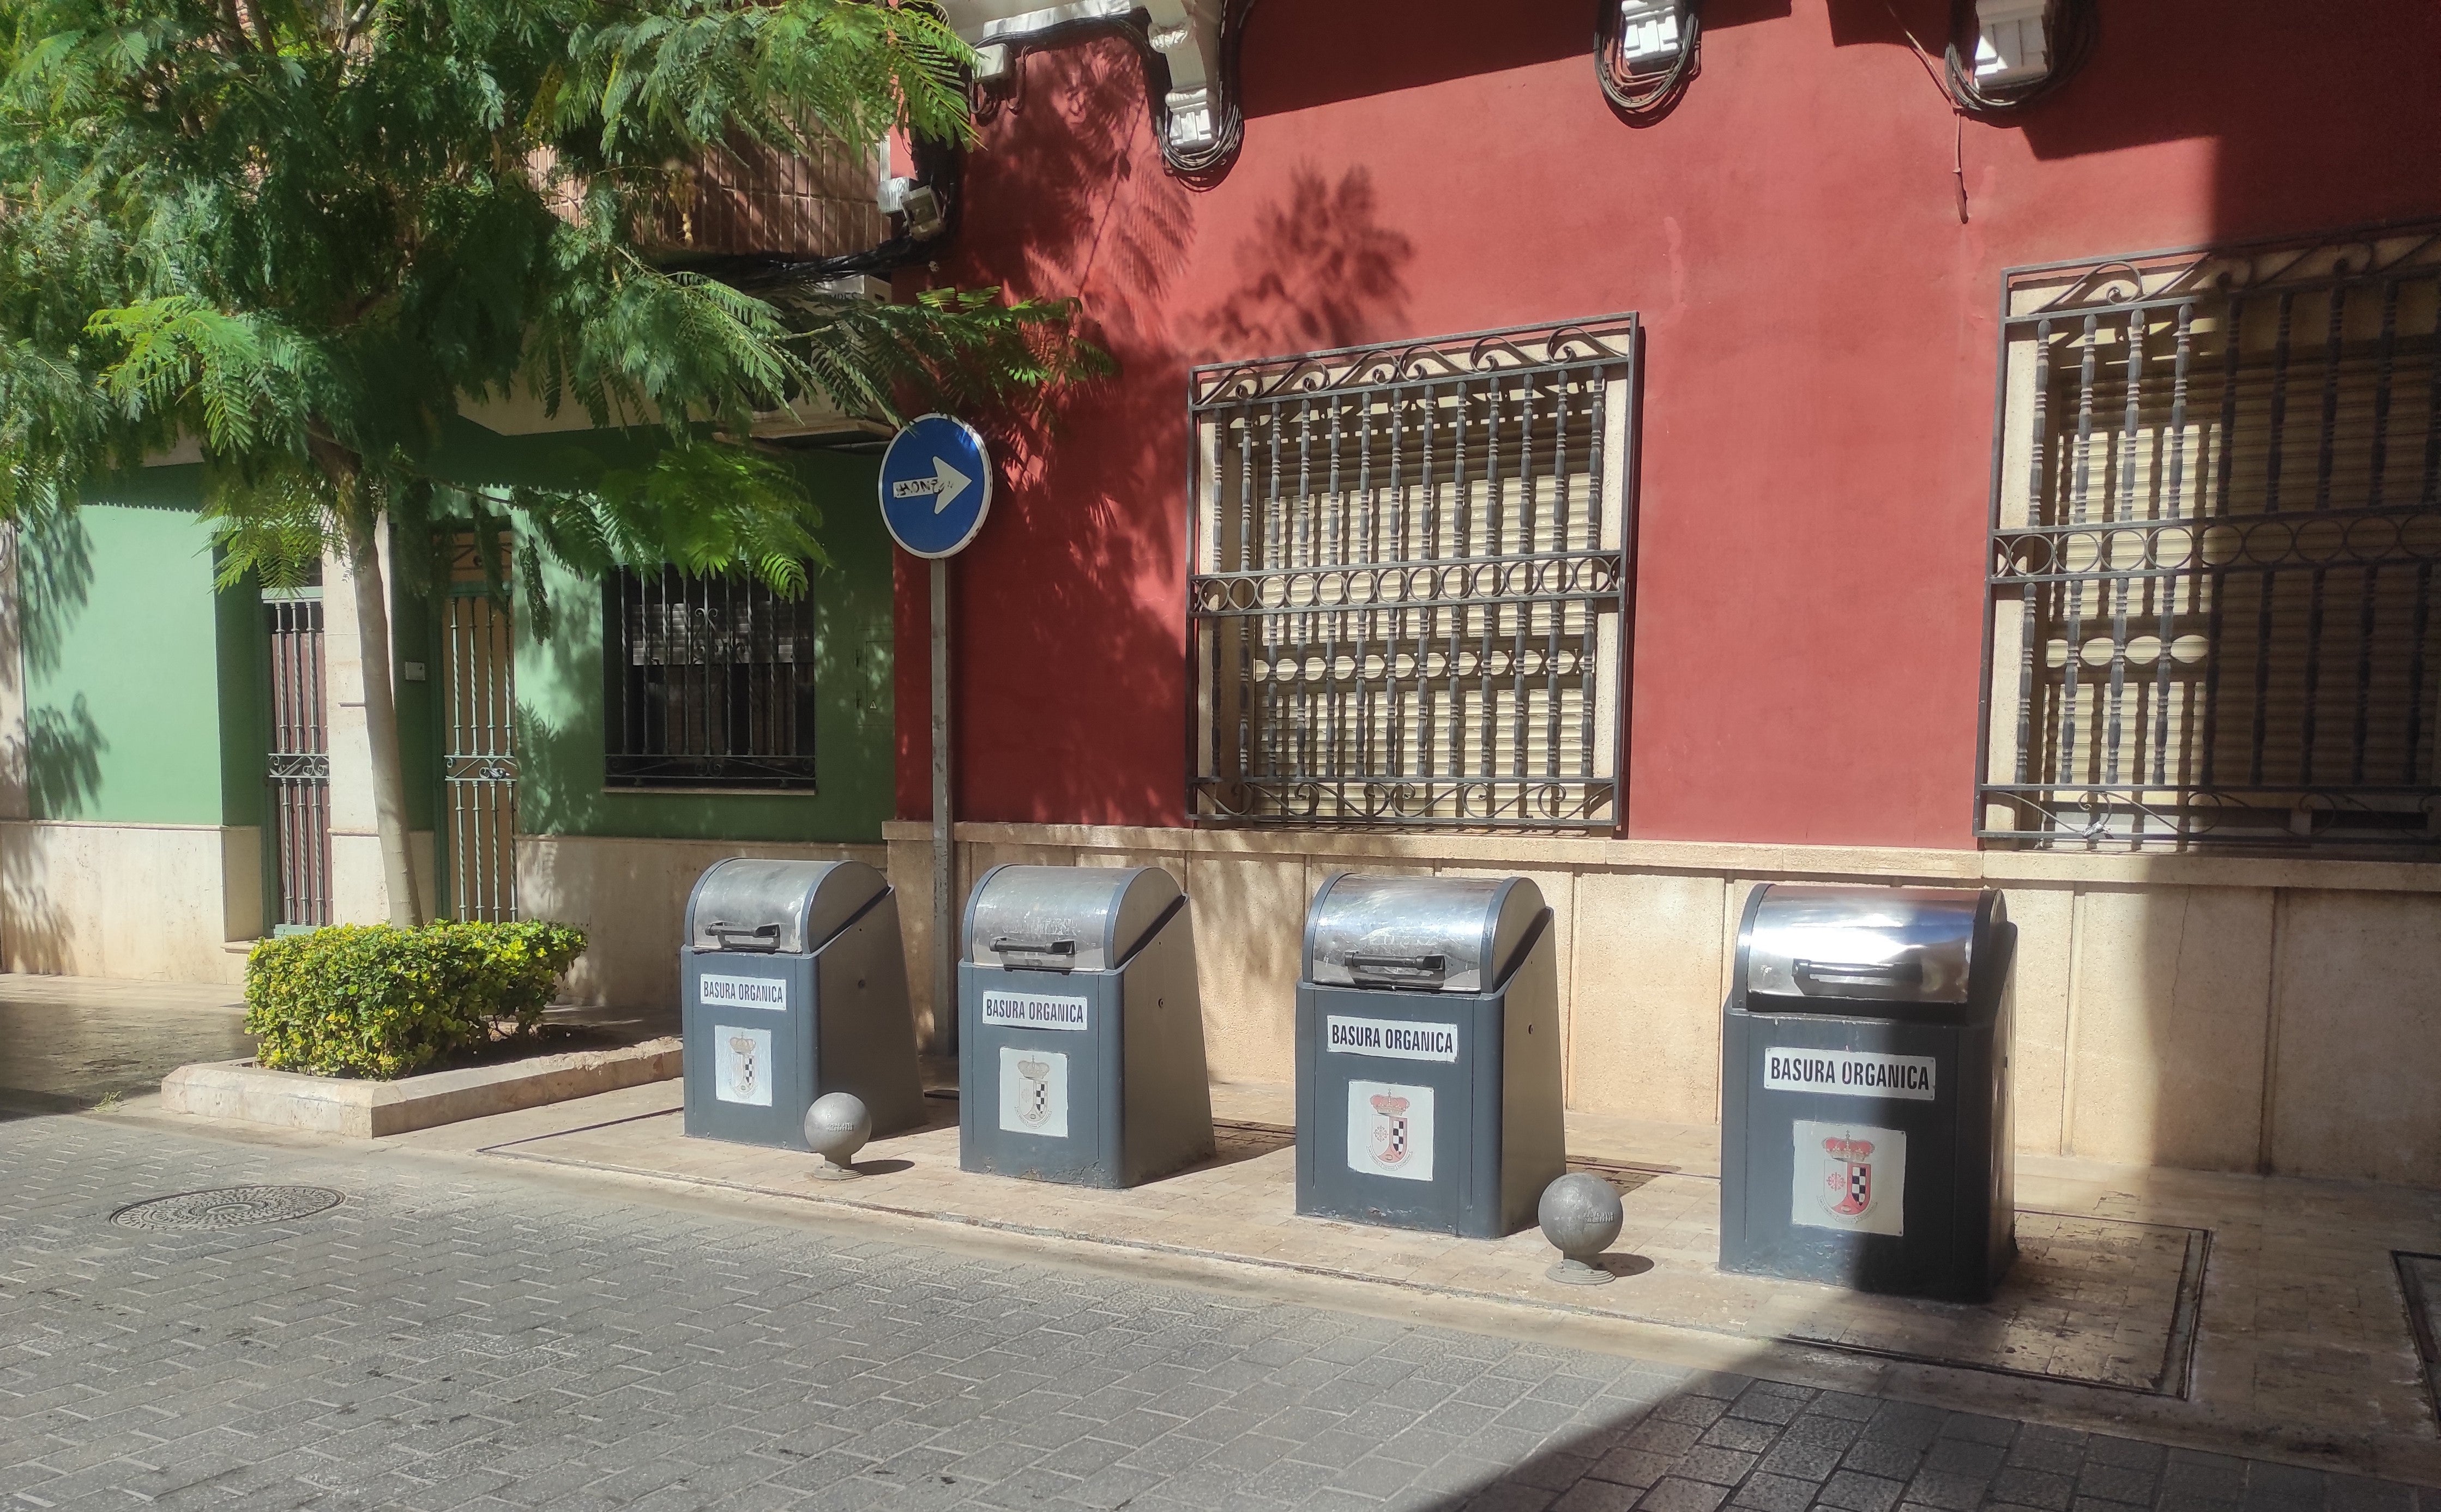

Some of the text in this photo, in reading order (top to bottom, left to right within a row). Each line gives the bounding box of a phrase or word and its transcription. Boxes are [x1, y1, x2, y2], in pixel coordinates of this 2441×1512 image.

[704, 981, 783, 1003] BASURA ORGANICA
[986, 999, 1083, 1023] BASURA ORGANICA
[1332, 1024, 1453, 1053] BASURA ORGANICA
[1771, 1057, 1929, 1090] BASURA ORGANICA
